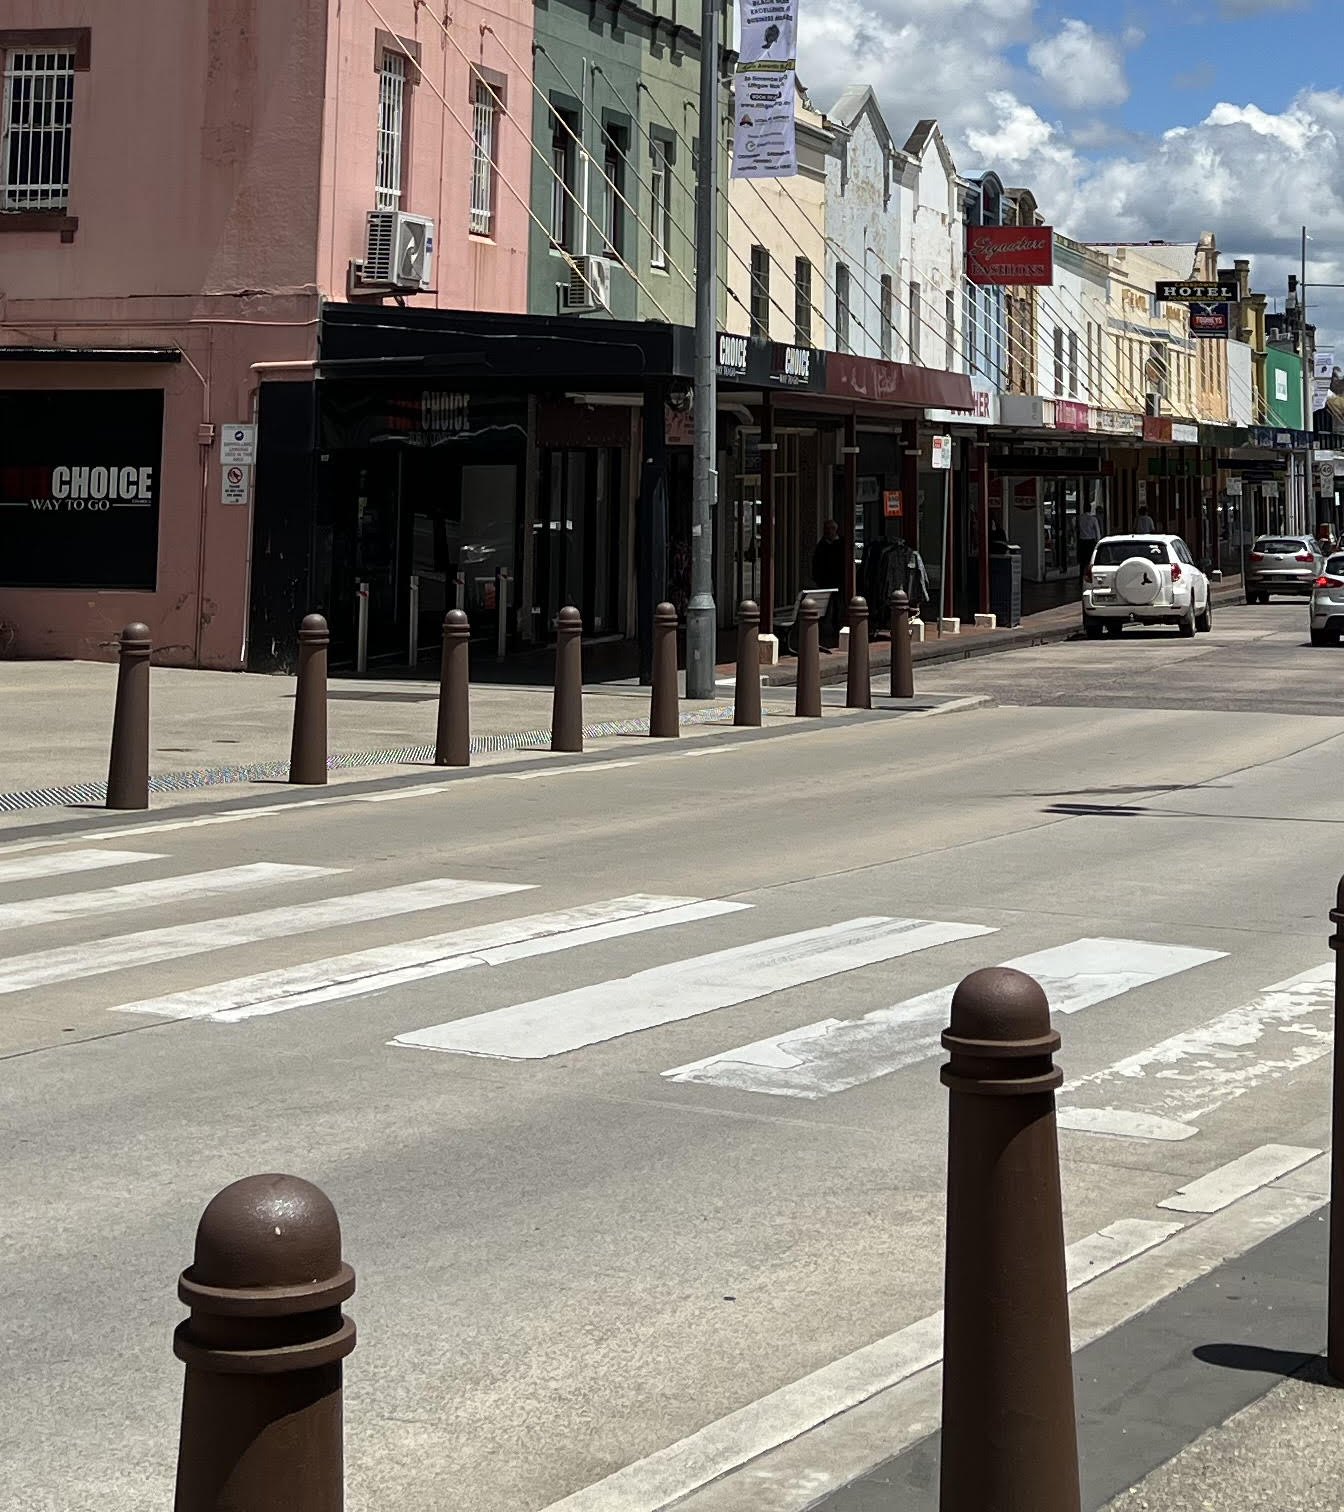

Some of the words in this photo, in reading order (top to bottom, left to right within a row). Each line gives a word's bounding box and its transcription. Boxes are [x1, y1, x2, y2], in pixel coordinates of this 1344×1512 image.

[969, 236, 1045, 261] Signature
[1163, 287, 1232, 297] HOTEL
[720, 335, 747, 367] CHOICE
[785, 346, 810, 377] CHOICE
[422, 391, 470, 430] CHOICE
[51, 465, 153, 498] CHOICE
[30, 498, 61, 511] WAY
[66, 499, 85, 511] TO
[87, 498, 111, 511] GO
